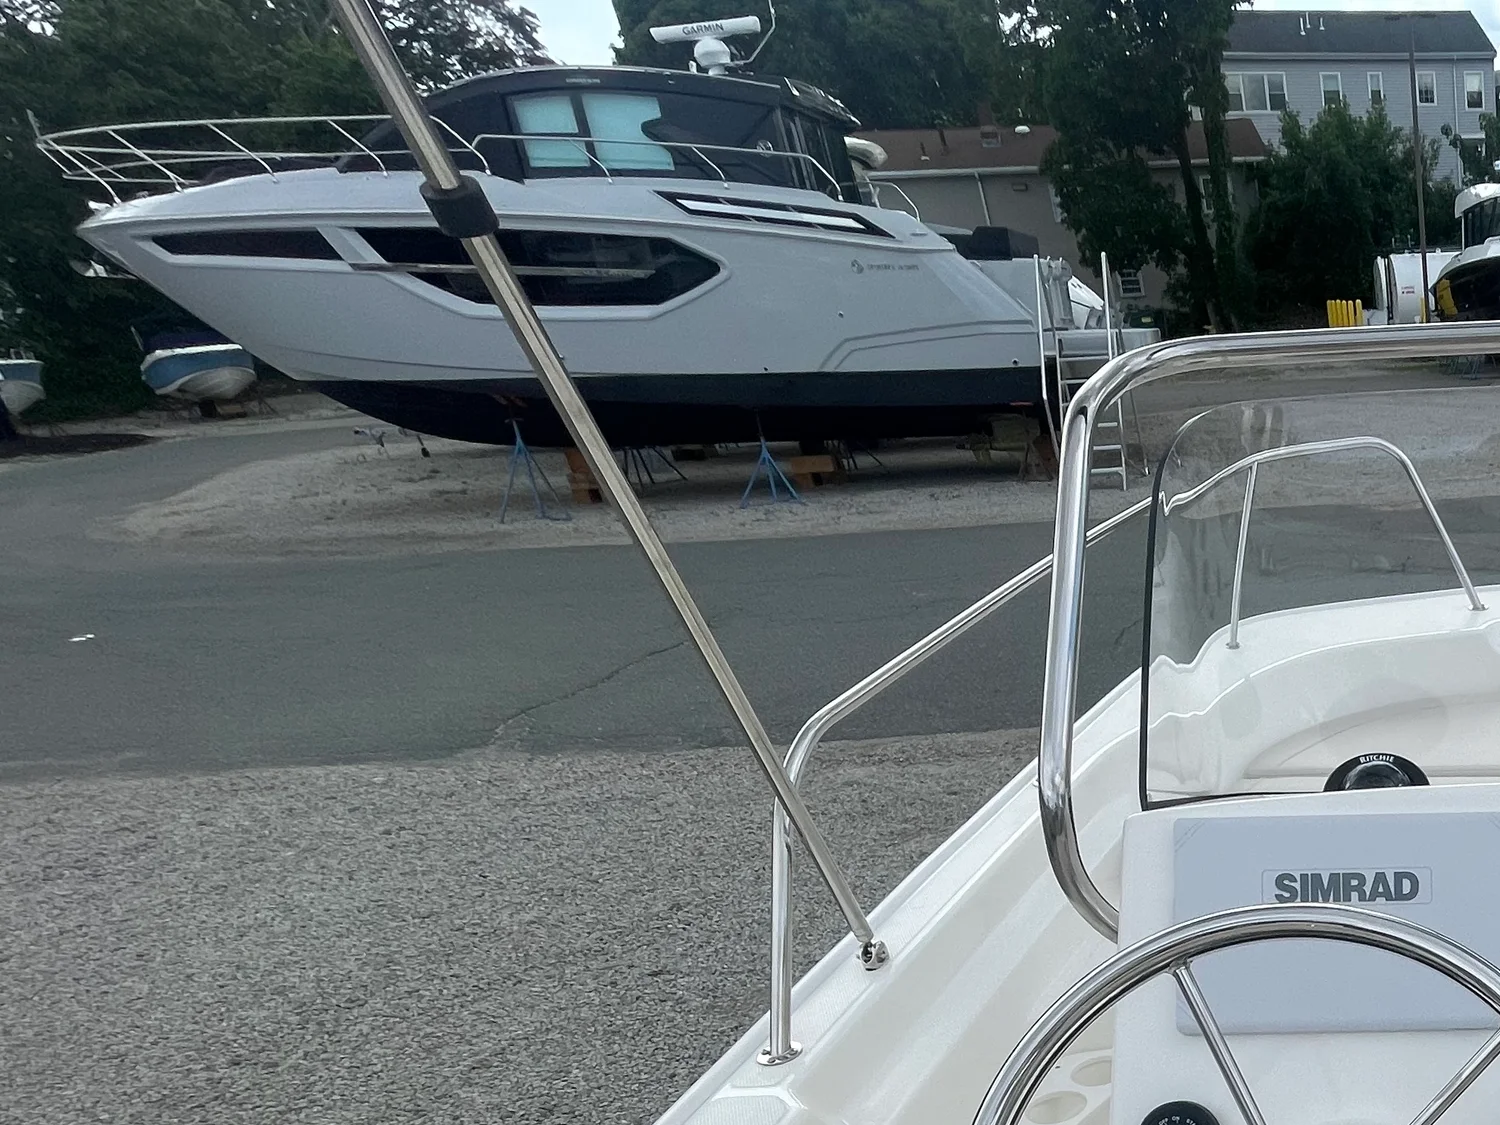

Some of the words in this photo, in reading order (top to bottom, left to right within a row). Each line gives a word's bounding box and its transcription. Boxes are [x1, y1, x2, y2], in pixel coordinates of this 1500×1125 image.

[682, 22, 724, 36] GARMIN
[1359, 754, 1395, 764] RITCHIE
[1274, 870, 1420, 903] SIMRAD
